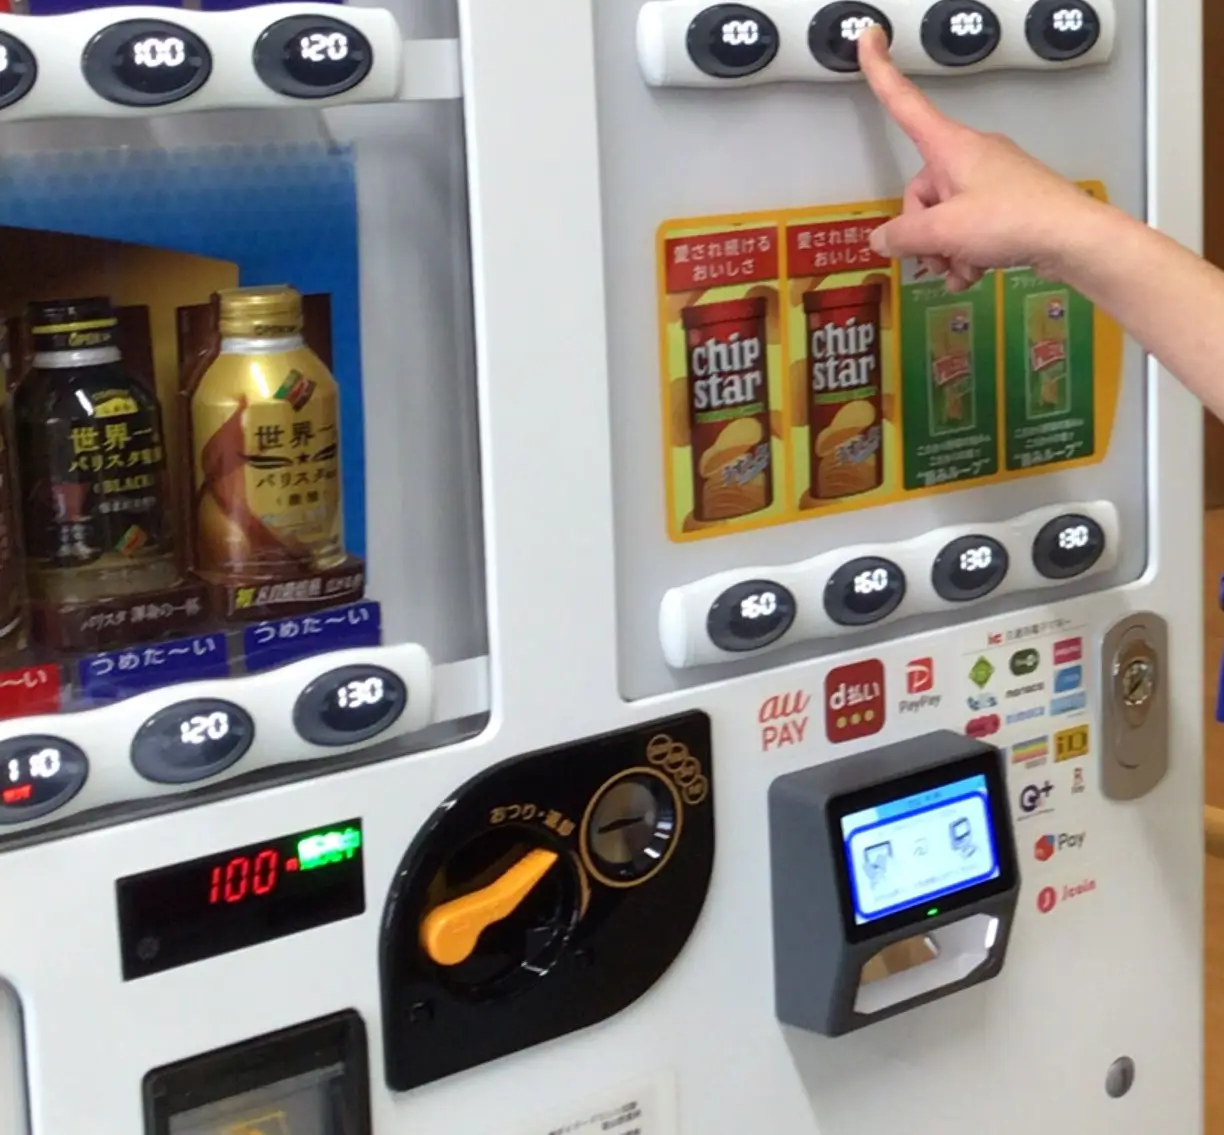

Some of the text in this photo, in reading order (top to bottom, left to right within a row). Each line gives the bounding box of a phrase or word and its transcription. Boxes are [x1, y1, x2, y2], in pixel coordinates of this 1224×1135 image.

[722, 19, 758, 46] 100
[950, 11, 984, 37] 100
[1053, 7, 1084, 31] 100
[134, 37, 186, 68] 100
[300, 32, 349, 63] 120
[674, 235, 772, 263] 愛され続ける
[797, 226, 873, 251] 愛され続け
[693, 259, 756, 282] おいしさ
[814, 248, 872, 268] おいしさ
[811, 317, 874, 358] chip
[692, 331, 760, 376] chip
[813, 351, 876, 391] star
[694, 369, 762, 410] star
[253, 420, 334, 452] 世界一
[1058, 524, 1089, 550] 130
[960, 546, 993, 571] 130
[854, 567, 888, 595] 160
[740, 591, 776, 620] 160
[337, 677, 384, 709] 130
[758, 690, 811, 723] au
[829, 681, 880, 711] d払い
[899, 694, 942, 714] PayPay
[180, 711, 230, 745] 120
[762, 716, 809, 751] PAY
[1057, 731, 1088, 756] iD
[8, 748, 61, 782] 110
[1058, 832, 1086, 851] Pay
[209, 849, 279, 904] 100
